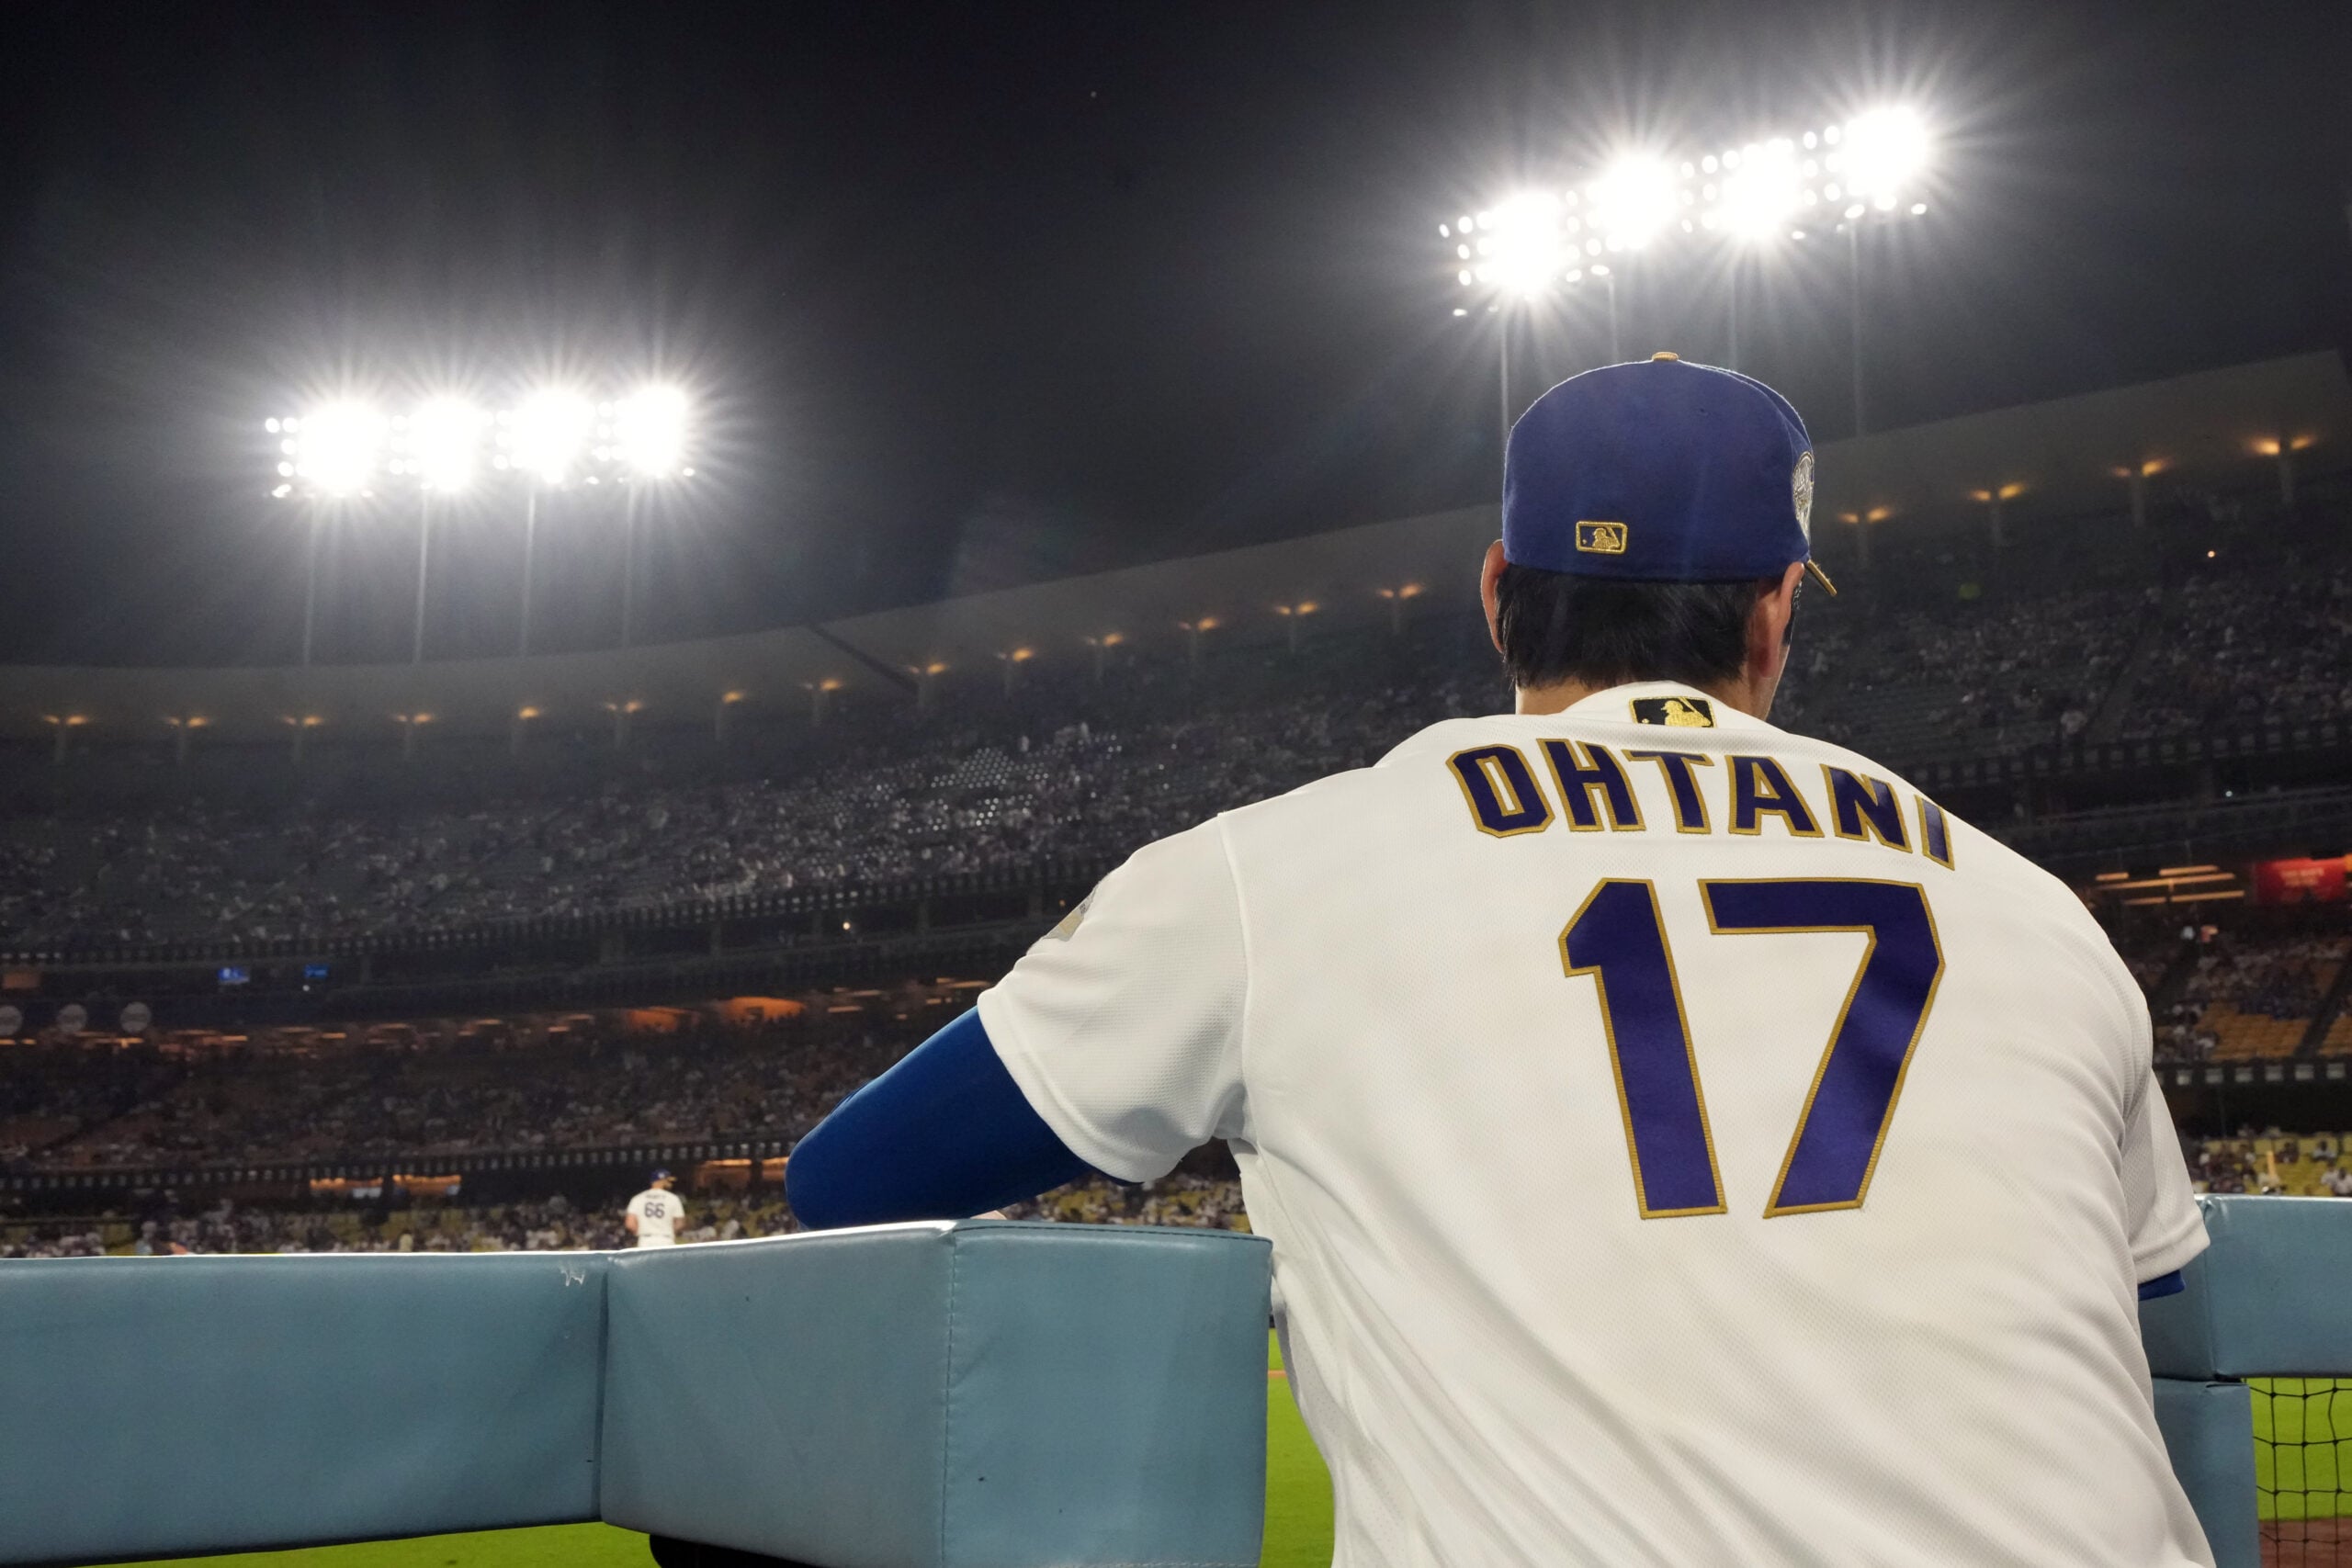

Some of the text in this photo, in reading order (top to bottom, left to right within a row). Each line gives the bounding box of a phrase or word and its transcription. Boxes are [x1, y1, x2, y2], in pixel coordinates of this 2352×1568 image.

[1445, 738, 1954, 870] OHTANI
[1558, 878, 1945, 1219] 17
[644, 1201, 665, 1219] 66
